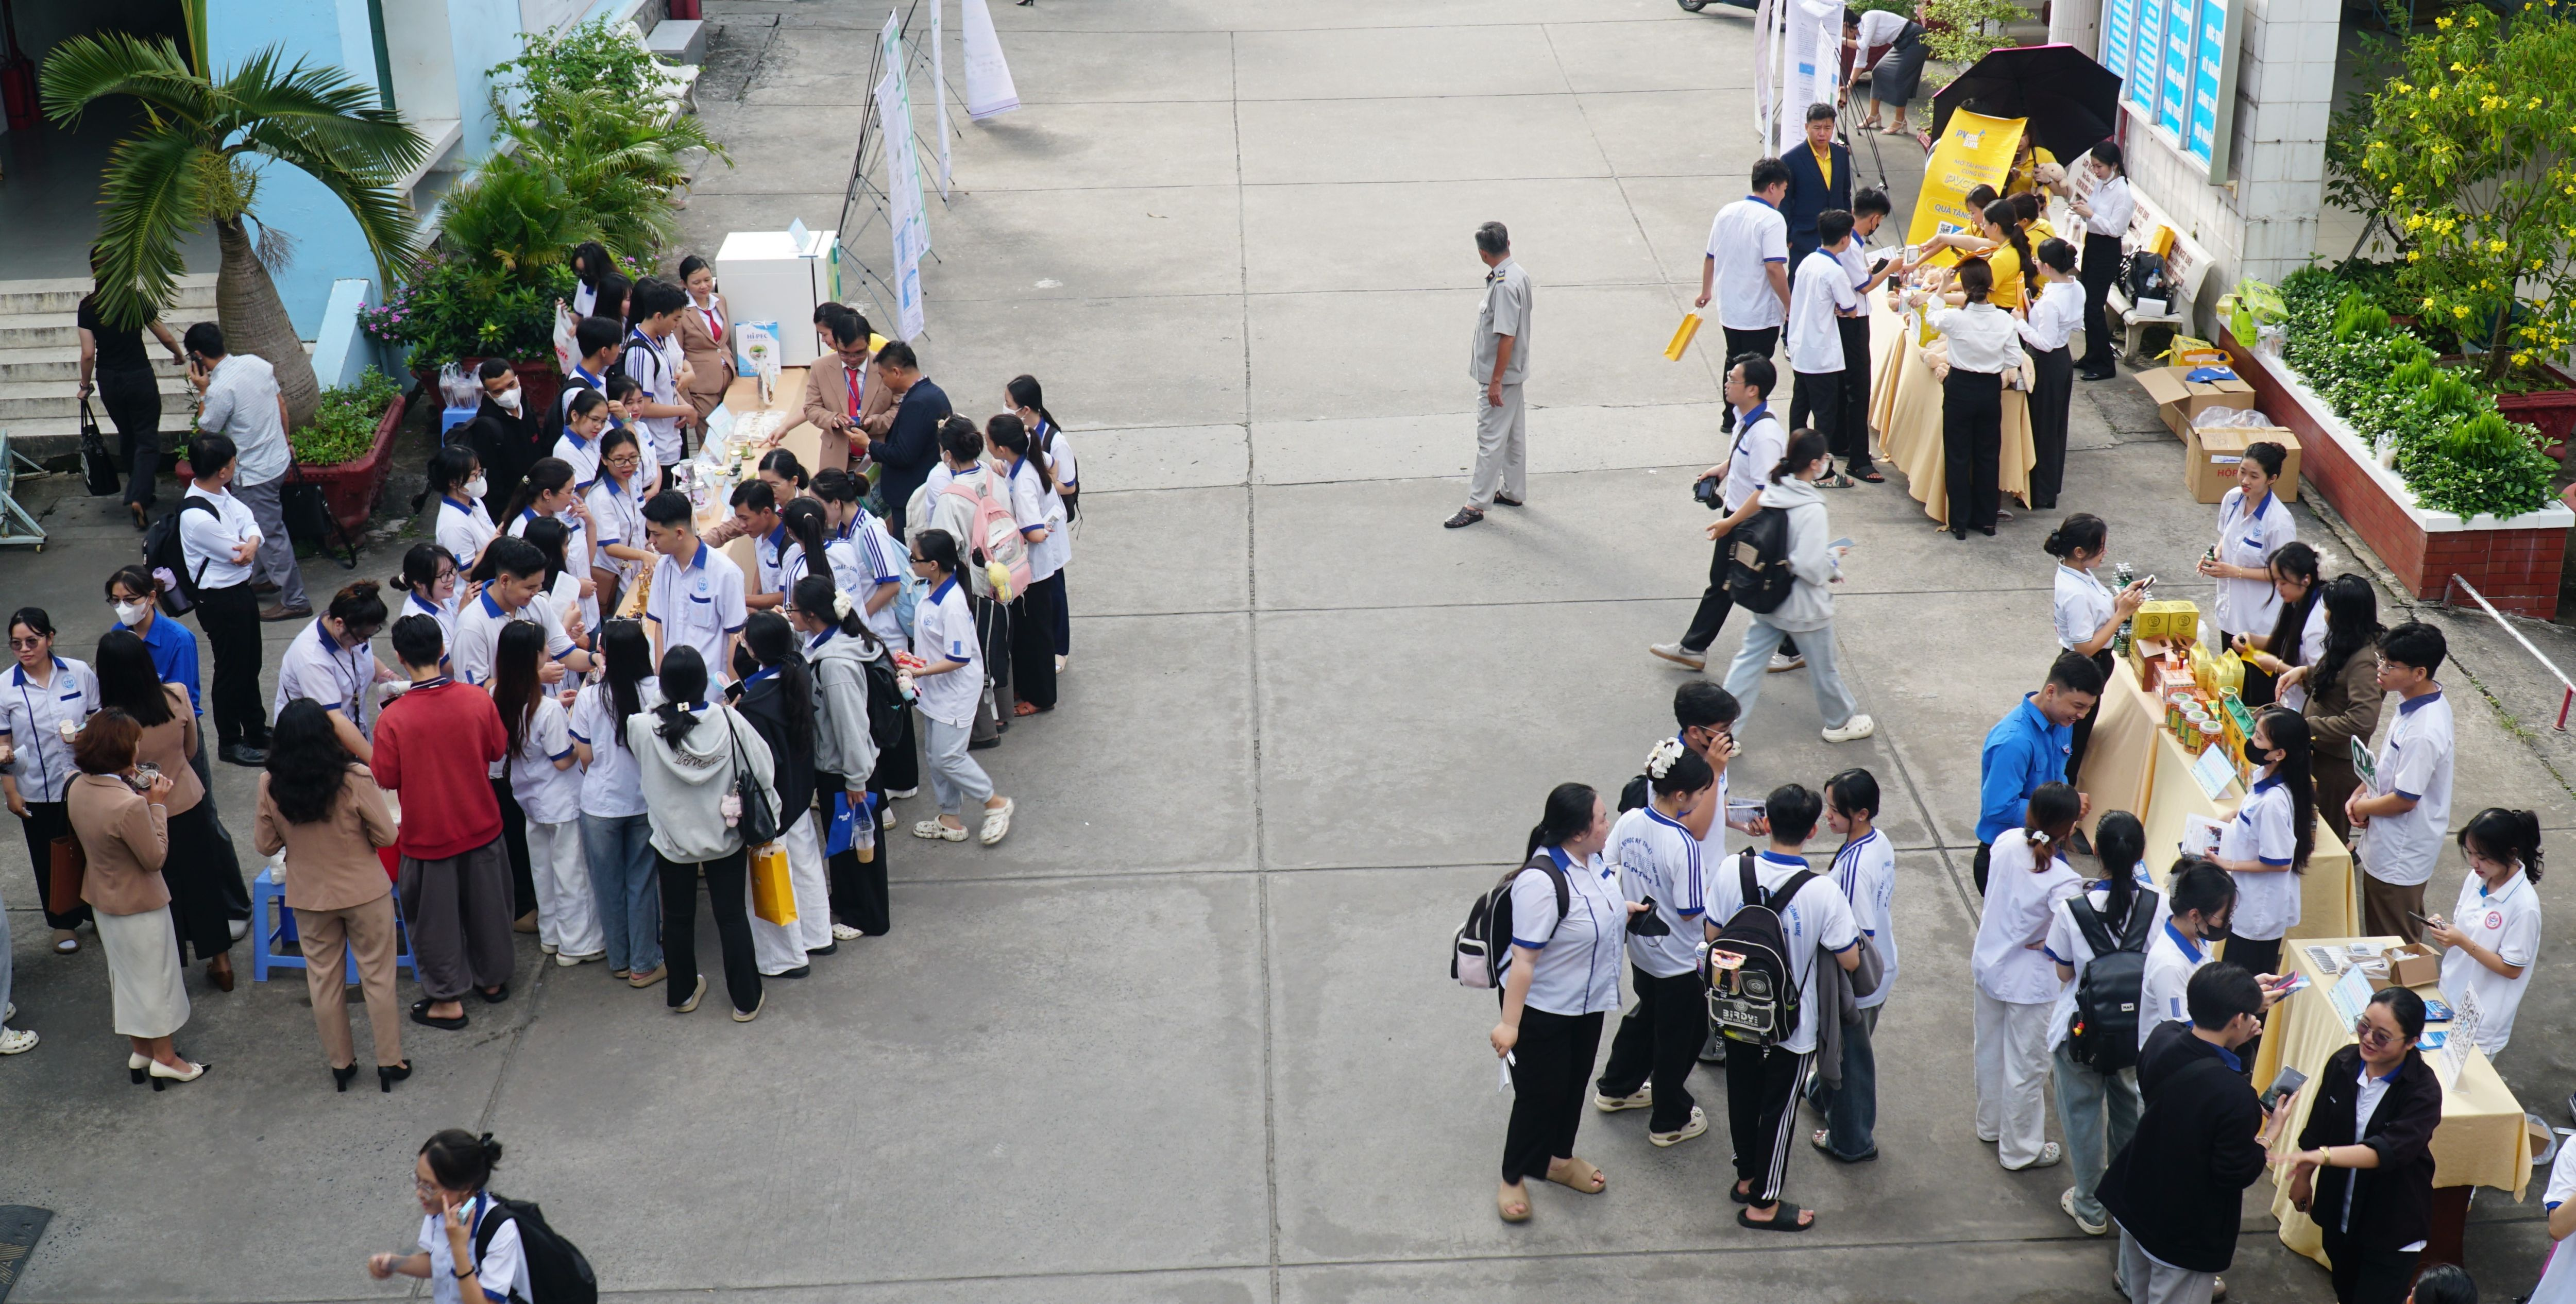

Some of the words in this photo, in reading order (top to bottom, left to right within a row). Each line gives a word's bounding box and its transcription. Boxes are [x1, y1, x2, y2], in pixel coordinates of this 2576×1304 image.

[1935, 204, 1951, 214] QUÀ
[1788, 904, 1800, 921] CÔNG
[1733, 1018, 1758, 1027] COLLECTION
